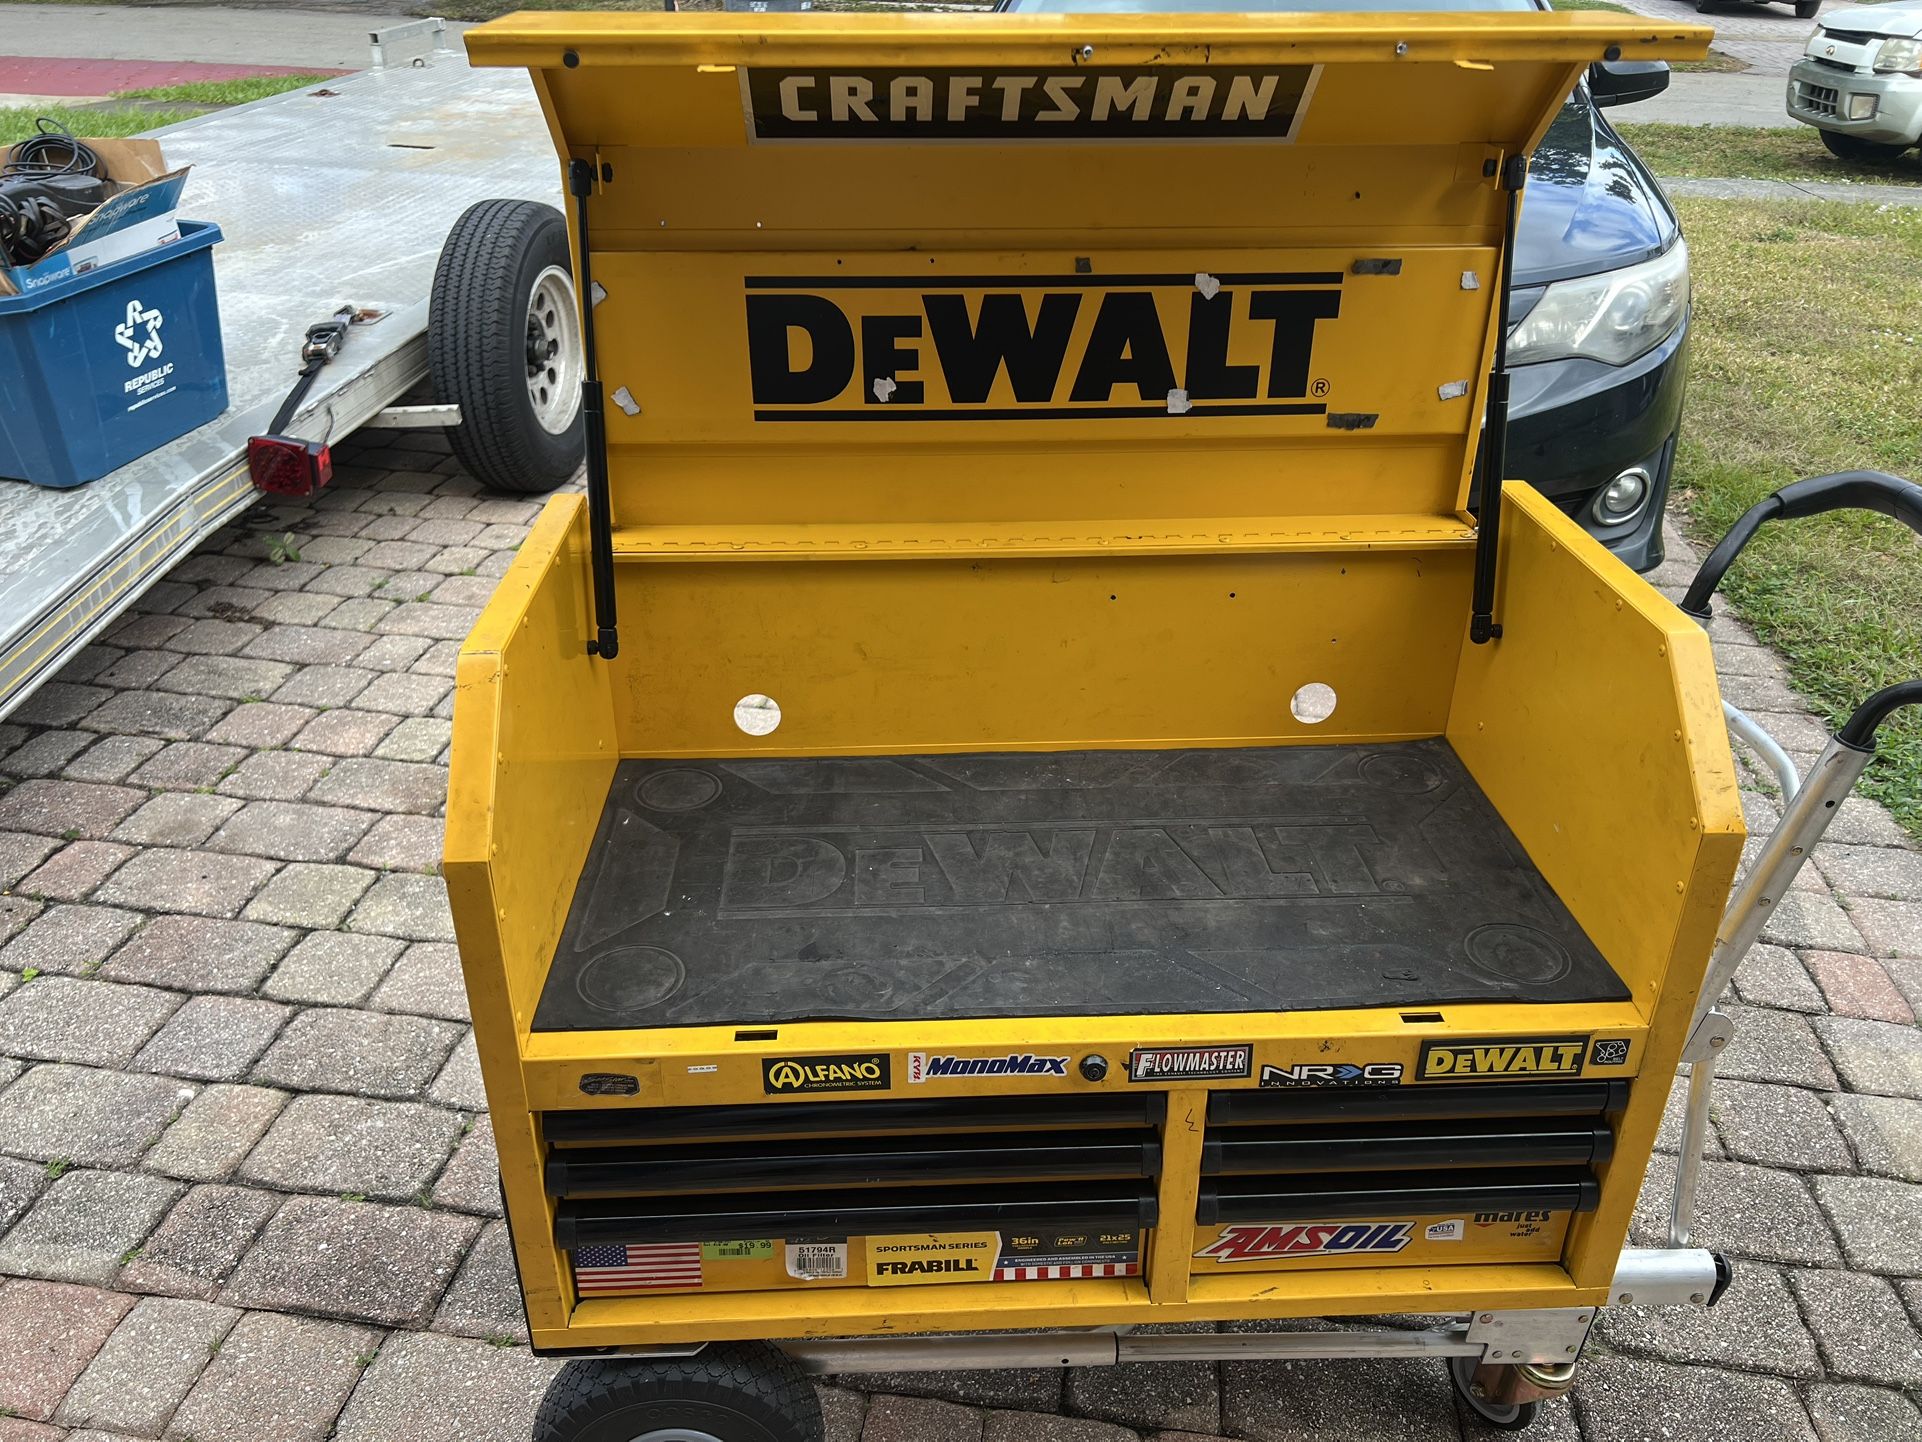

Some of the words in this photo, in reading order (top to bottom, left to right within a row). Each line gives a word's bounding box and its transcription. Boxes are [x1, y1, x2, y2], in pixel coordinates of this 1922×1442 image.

[778, 74, 1280, 122] CRAFTSMAN
[25, 267, 71, 289] Snapware
[745, 289, 1342, 405] DEWALT
[124, 362, 174, 394] REPUBLIC
[136, 377, 165, 396] SERVICES
[720, 822, 1385, 907] DEWALT
[926, 1055, 1068, 1076] MonoMax
[1136, 1050, 1245, 1078] FLOWMASTER
[1425, 1046, 1582, 1074] DEWALT
[768, 1060, 881, 1089] ALFANO
[804, 1080, 856, 1089] CHRONOMETRIC
[857, 1079, 882, 1087] SYSTEM
[1474, 1210, 1552, 1223] mares
[738, 1241, 772, 1249] $19.99
[876, 1243, 946, 1253] SPORTSMAN
[948, 1241, 988, 1250] SERIES
[1011, 1236, 1039, 1245] 36in
[1099, 1233, 1131, 1241] 21x25
[1206, 1225, 1408, 1259] AMSOIL
[798, 1246, 836, 1254] 51794R
[876, 1258, 979, 1276] FRABILL
